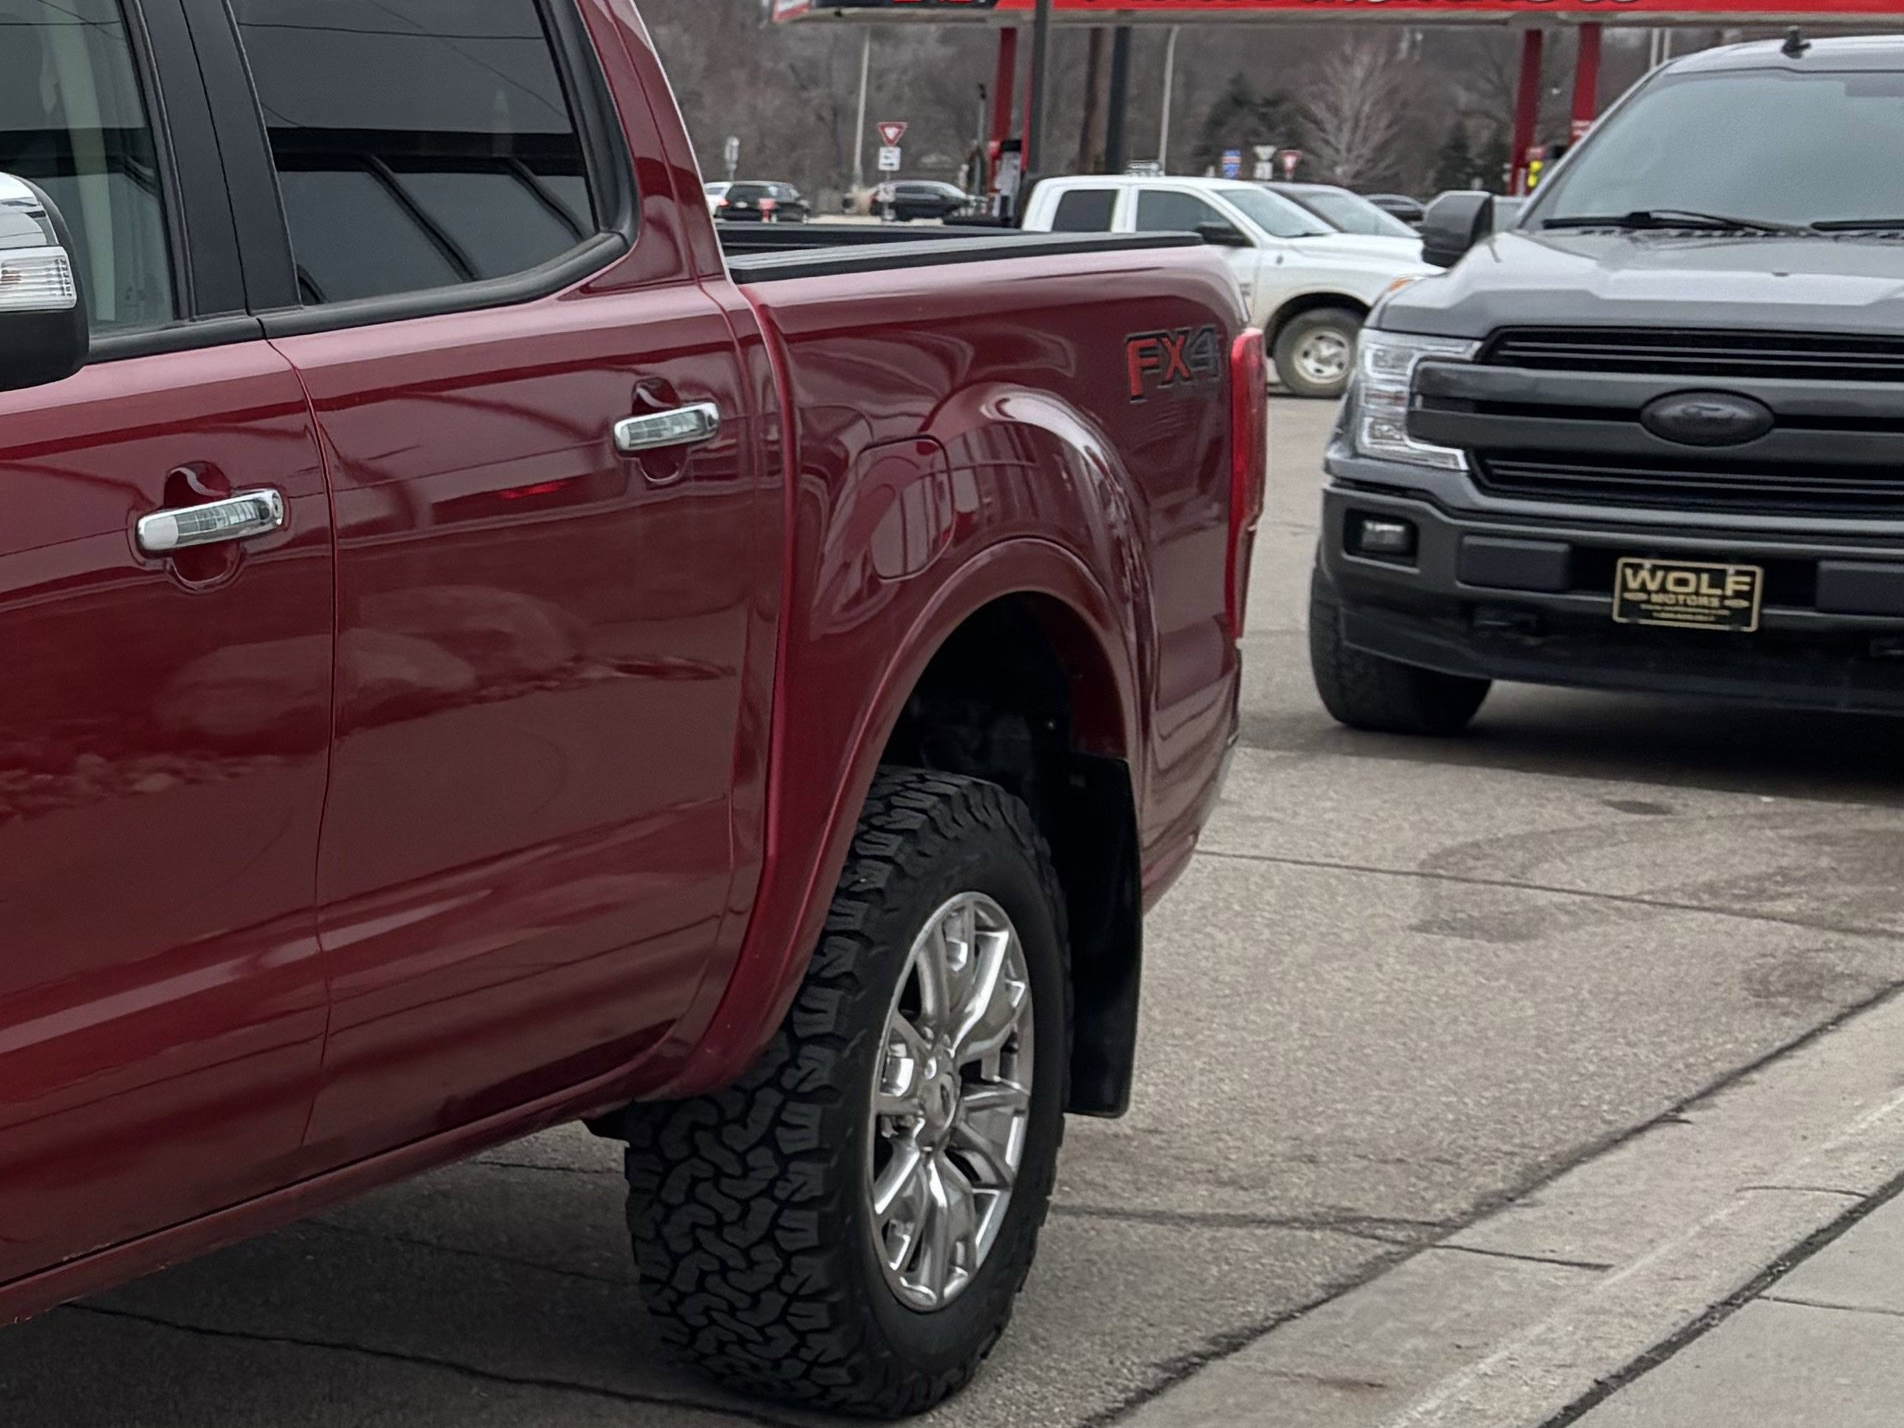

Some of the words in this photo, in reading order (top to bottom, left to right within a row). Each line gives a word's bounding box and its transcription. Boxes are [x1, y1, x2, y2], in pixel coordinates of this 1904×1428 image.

[1124, 324, 1221, 404] FX4
[1624, 567, 1752, 597] WOLF
[1650, 593, 1721, 608] MOTORS
